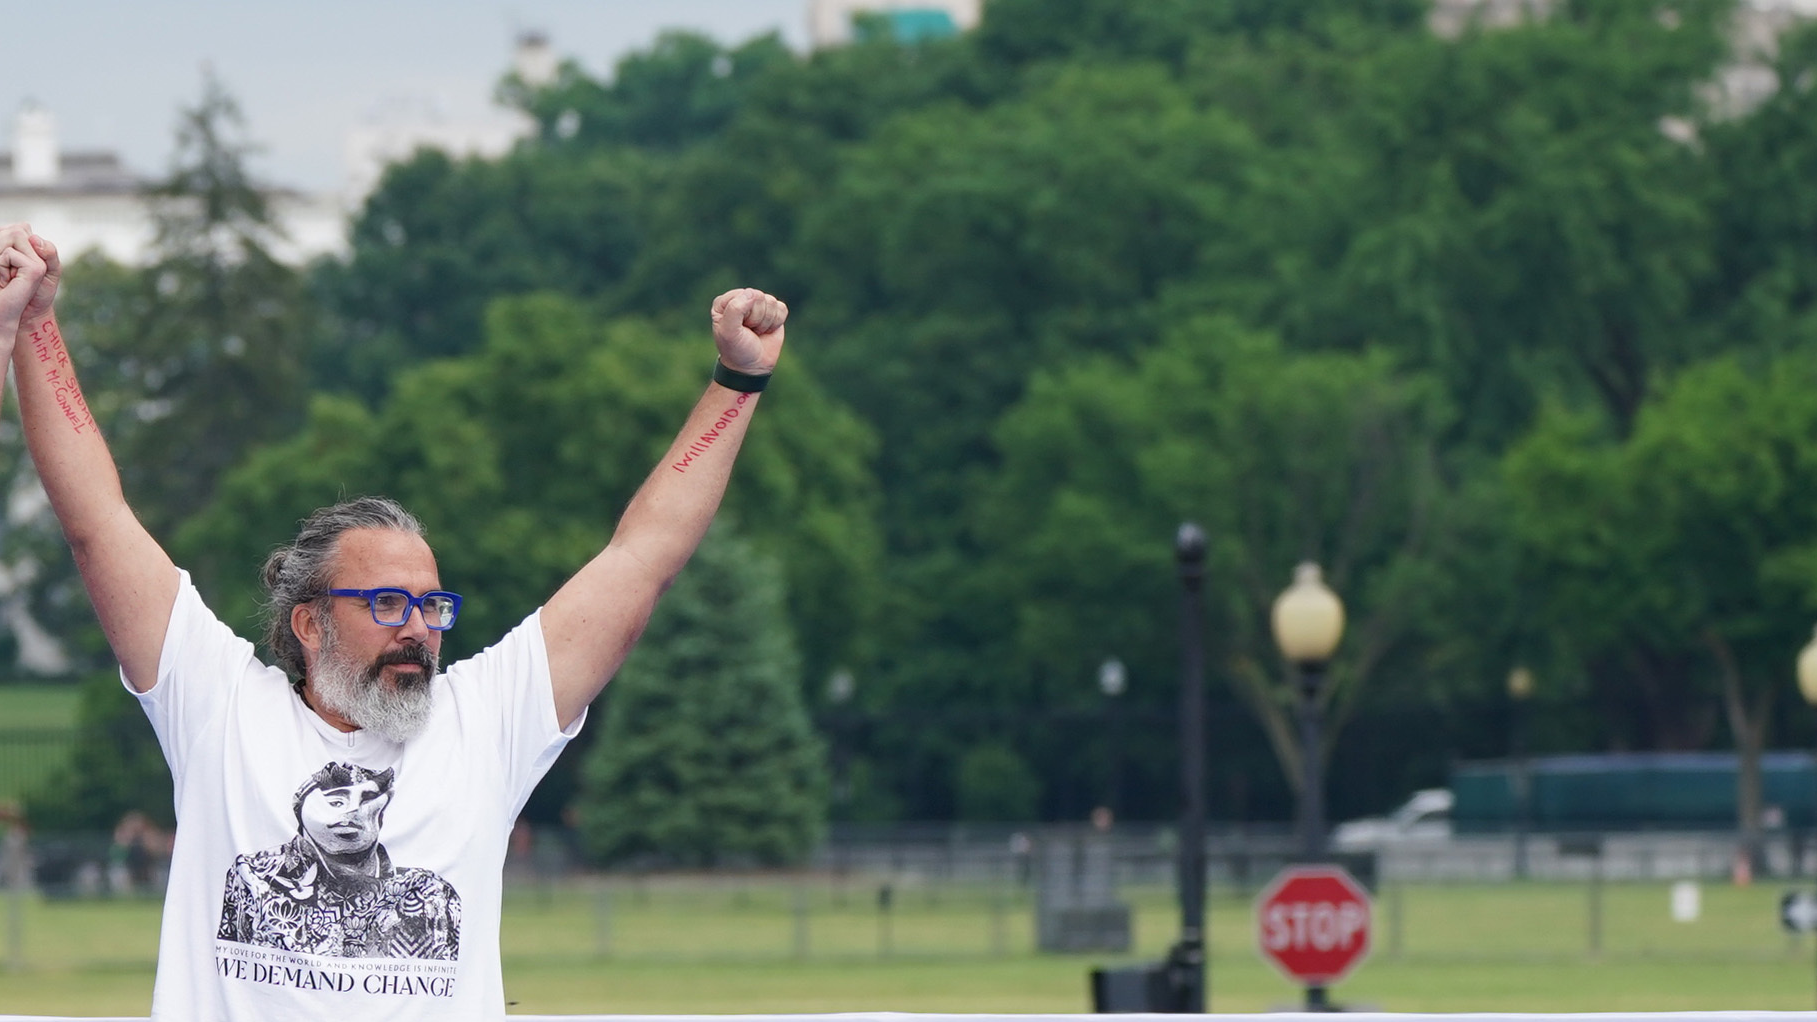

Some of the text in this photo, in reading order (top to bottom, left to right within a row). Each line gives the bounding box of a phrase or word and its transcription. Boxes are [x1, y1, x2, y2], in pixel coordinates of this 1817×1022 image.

[43, 321, 68, 368] CHUCK
[1264, 901, 1365, 951] STOP
[215, 956, 456, 998] WE DEMAND CHANGE
[230, 948, 250, 959] LOVE
[251, 951, 268, 961] FOR
[271, 953, 287, 963] THE
[289, 956, 322, 968] WORLD
[326, 962, 348, 970] AND
[351, 964, 411, 973] KNOWLEDGE
[414, 965, 422, 973] IS
[424, 965, 457, 975] INFINITE
